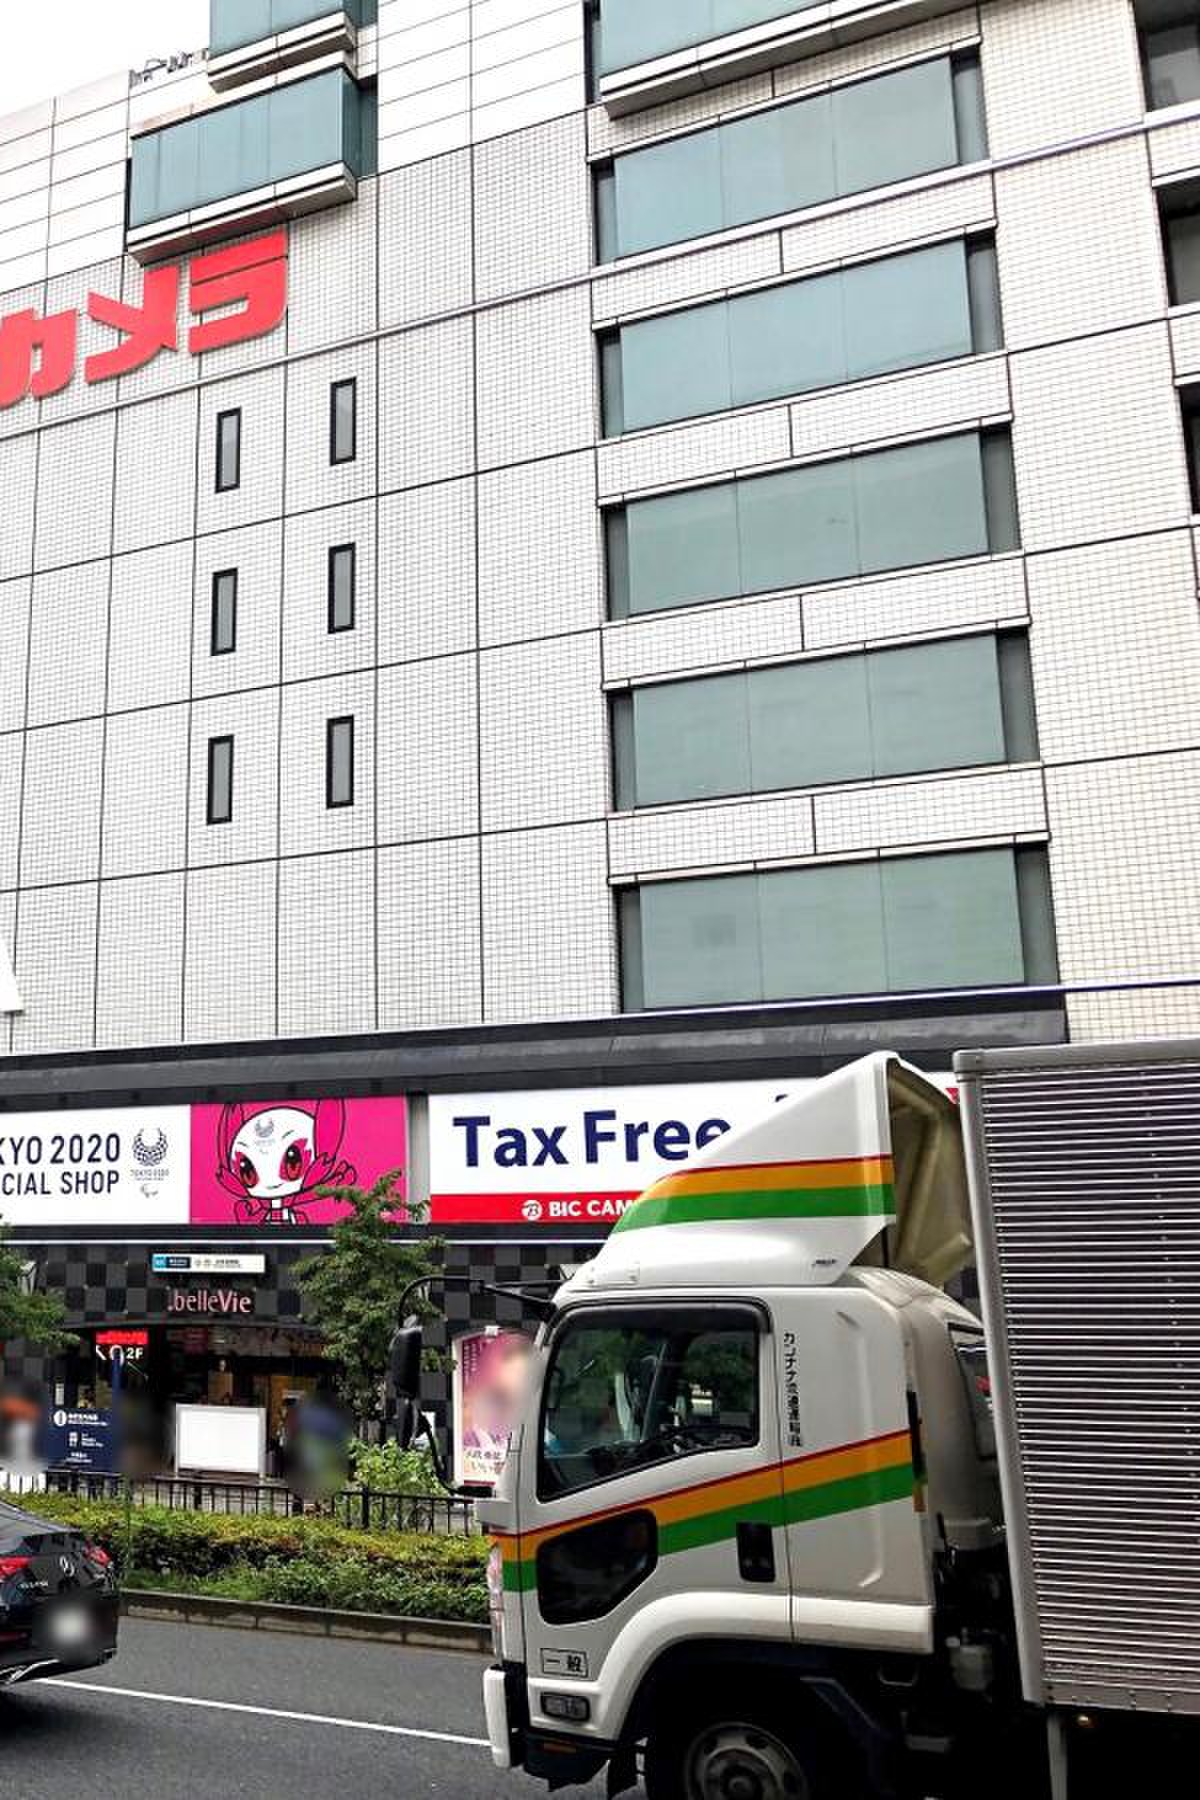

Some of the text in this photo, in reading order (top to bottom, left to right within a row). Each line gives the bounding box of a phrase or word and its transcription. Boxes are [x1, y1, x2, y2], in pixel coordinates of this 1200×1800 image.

[50, 1133, 121, 1164] 2020
[452, 1115, 569, 1168] Tax
[60, 1170, 119, 1194] SHOP
[549, 1203, 582, 1217] BIC
